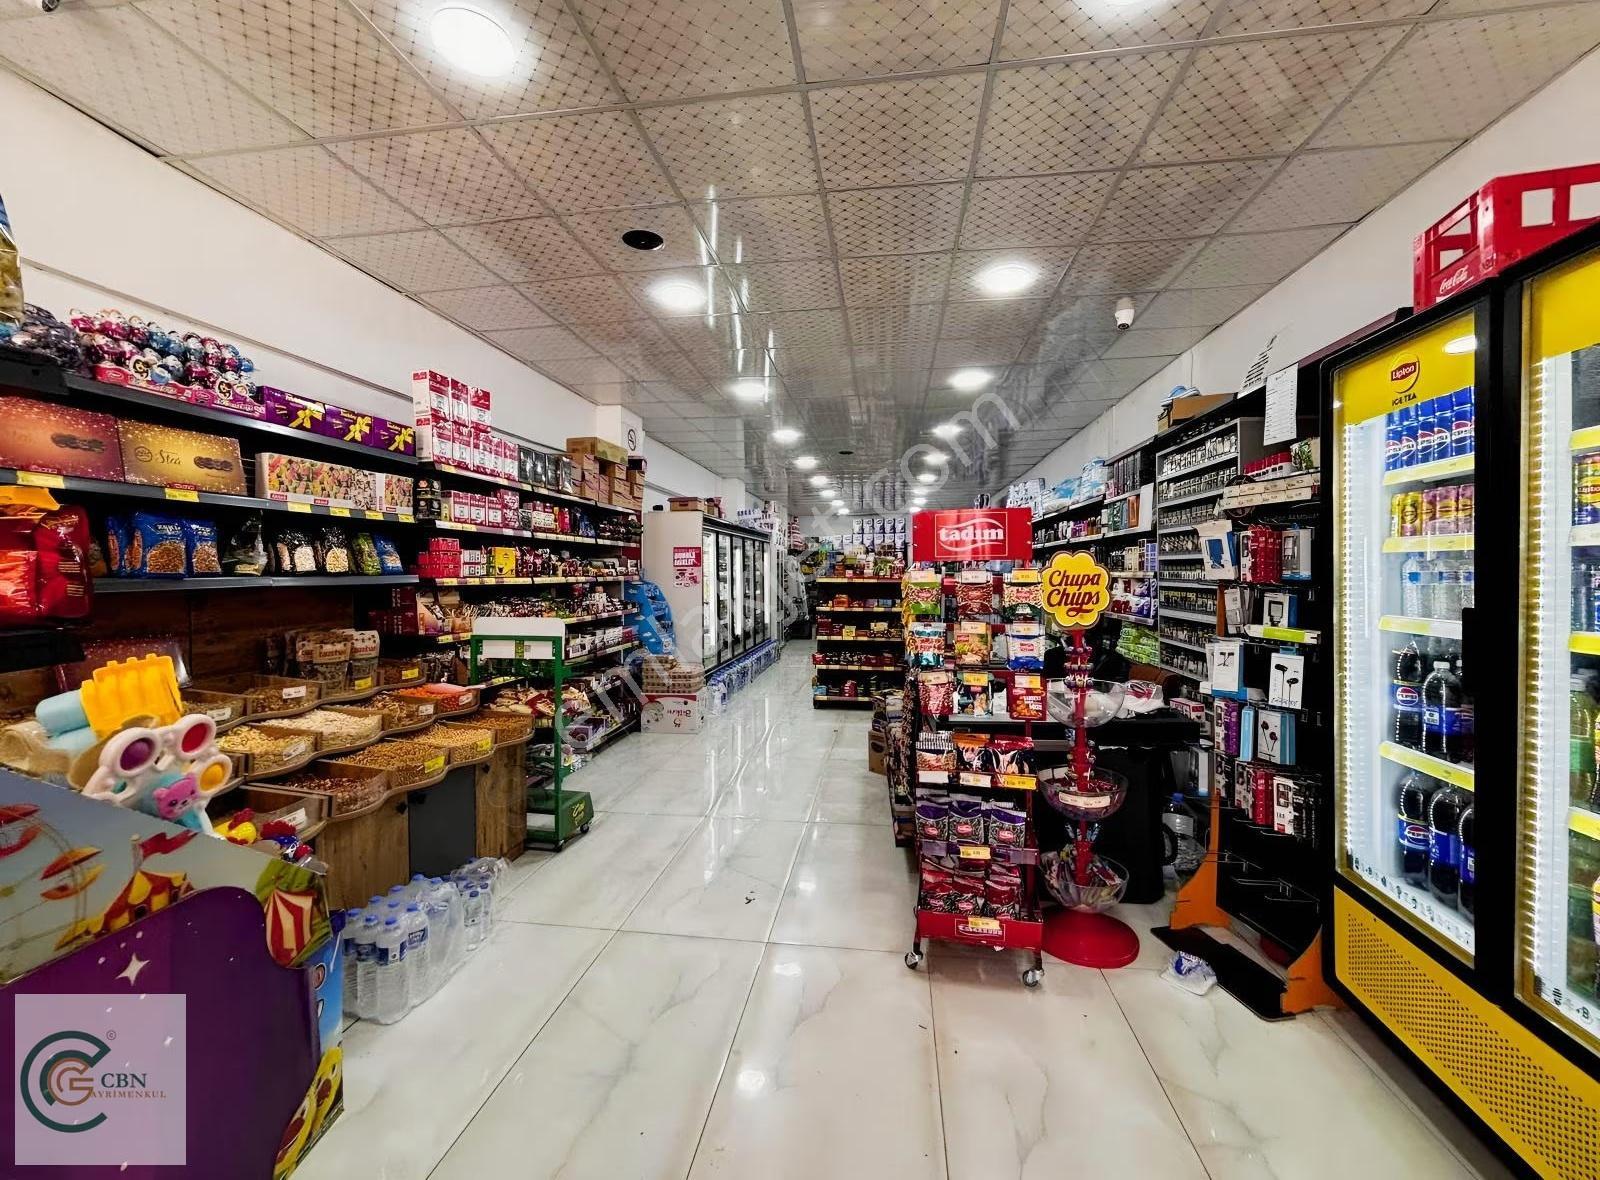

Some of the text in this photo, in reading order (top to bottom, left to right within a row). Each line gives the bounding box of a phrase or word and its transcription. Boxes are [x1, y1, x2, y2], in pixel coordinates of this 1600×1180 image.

[1392, 365, 1415, 380] Lipton
[1392, 392, 1417, 407] ICE TEA
[1048, 570, 1101, 591] Chupa
[1046, 588, 1101, 617] Chups
